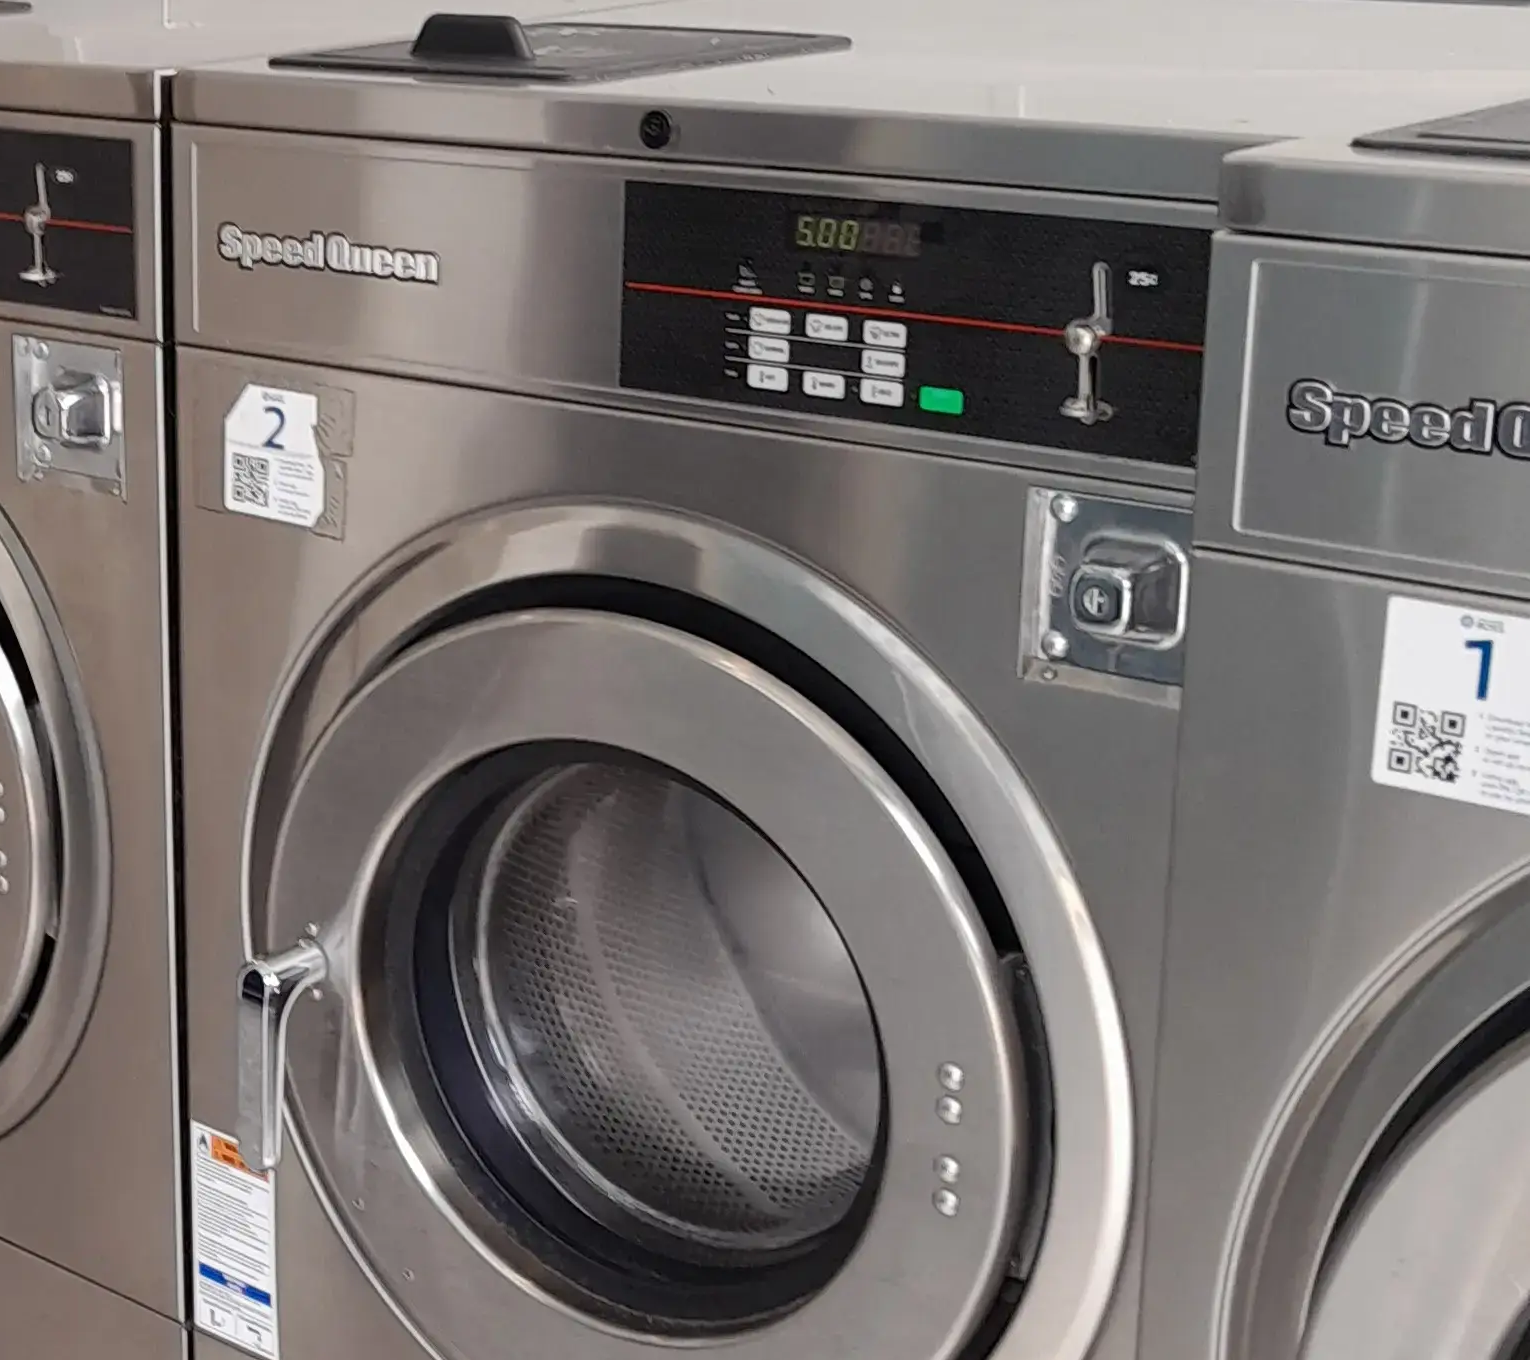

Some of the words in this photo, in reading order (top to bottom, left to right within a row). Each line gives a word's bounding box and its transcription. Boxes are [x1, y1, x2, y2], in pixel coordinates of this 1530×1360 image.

[218, 221, 325, 271] Speed
[326, 232, 439, 285] Queen
[262, 405, 286, 450] 2
[1286, 378, 1497, 456] Speed
[1464, 639, 1494, 701] 1
